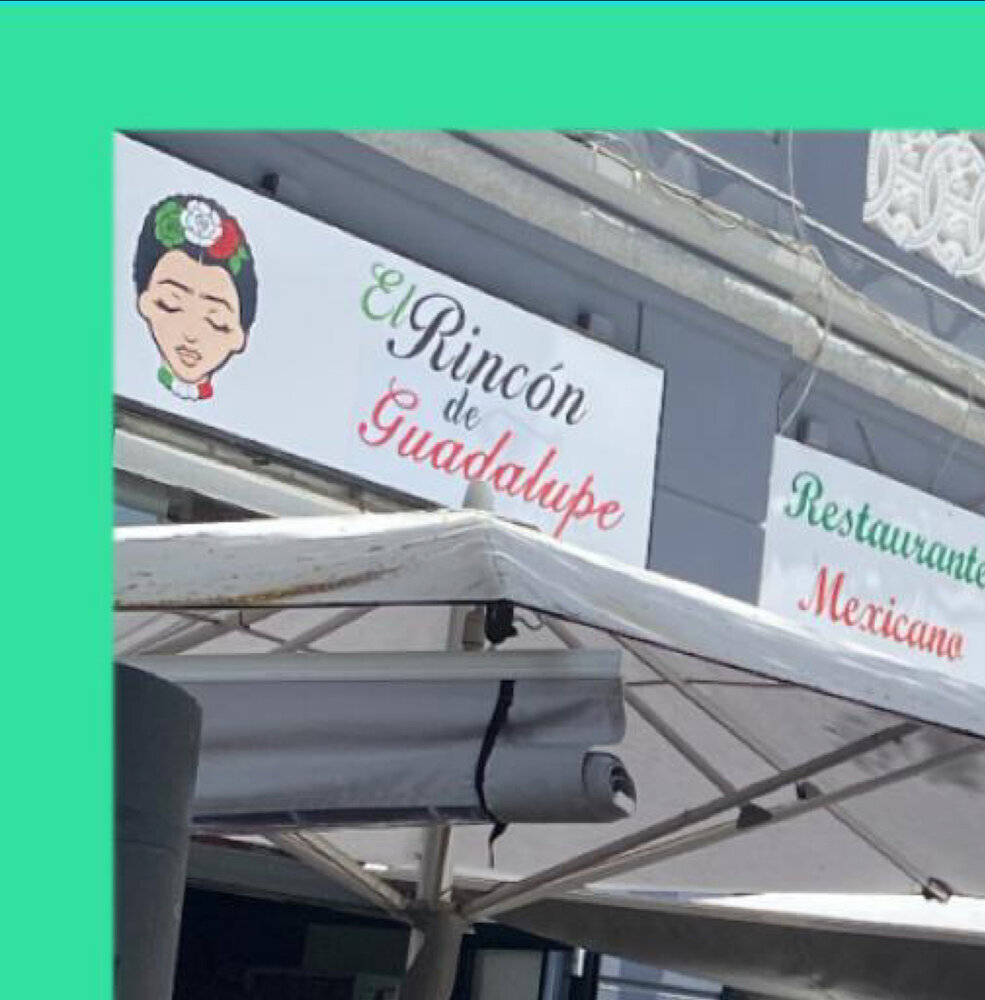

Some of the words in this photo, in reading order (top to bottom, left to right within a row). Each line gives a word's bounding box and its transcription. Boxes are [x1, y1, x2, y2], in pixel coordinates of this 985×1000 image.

[360, 262, 416, 328] El
[386, 293, 590, 426] Rincón
[442, 387, 482, 431] de
[358, 376, 625, 539] Guadalupe
[798, 566, 965, 661] Mexicano
